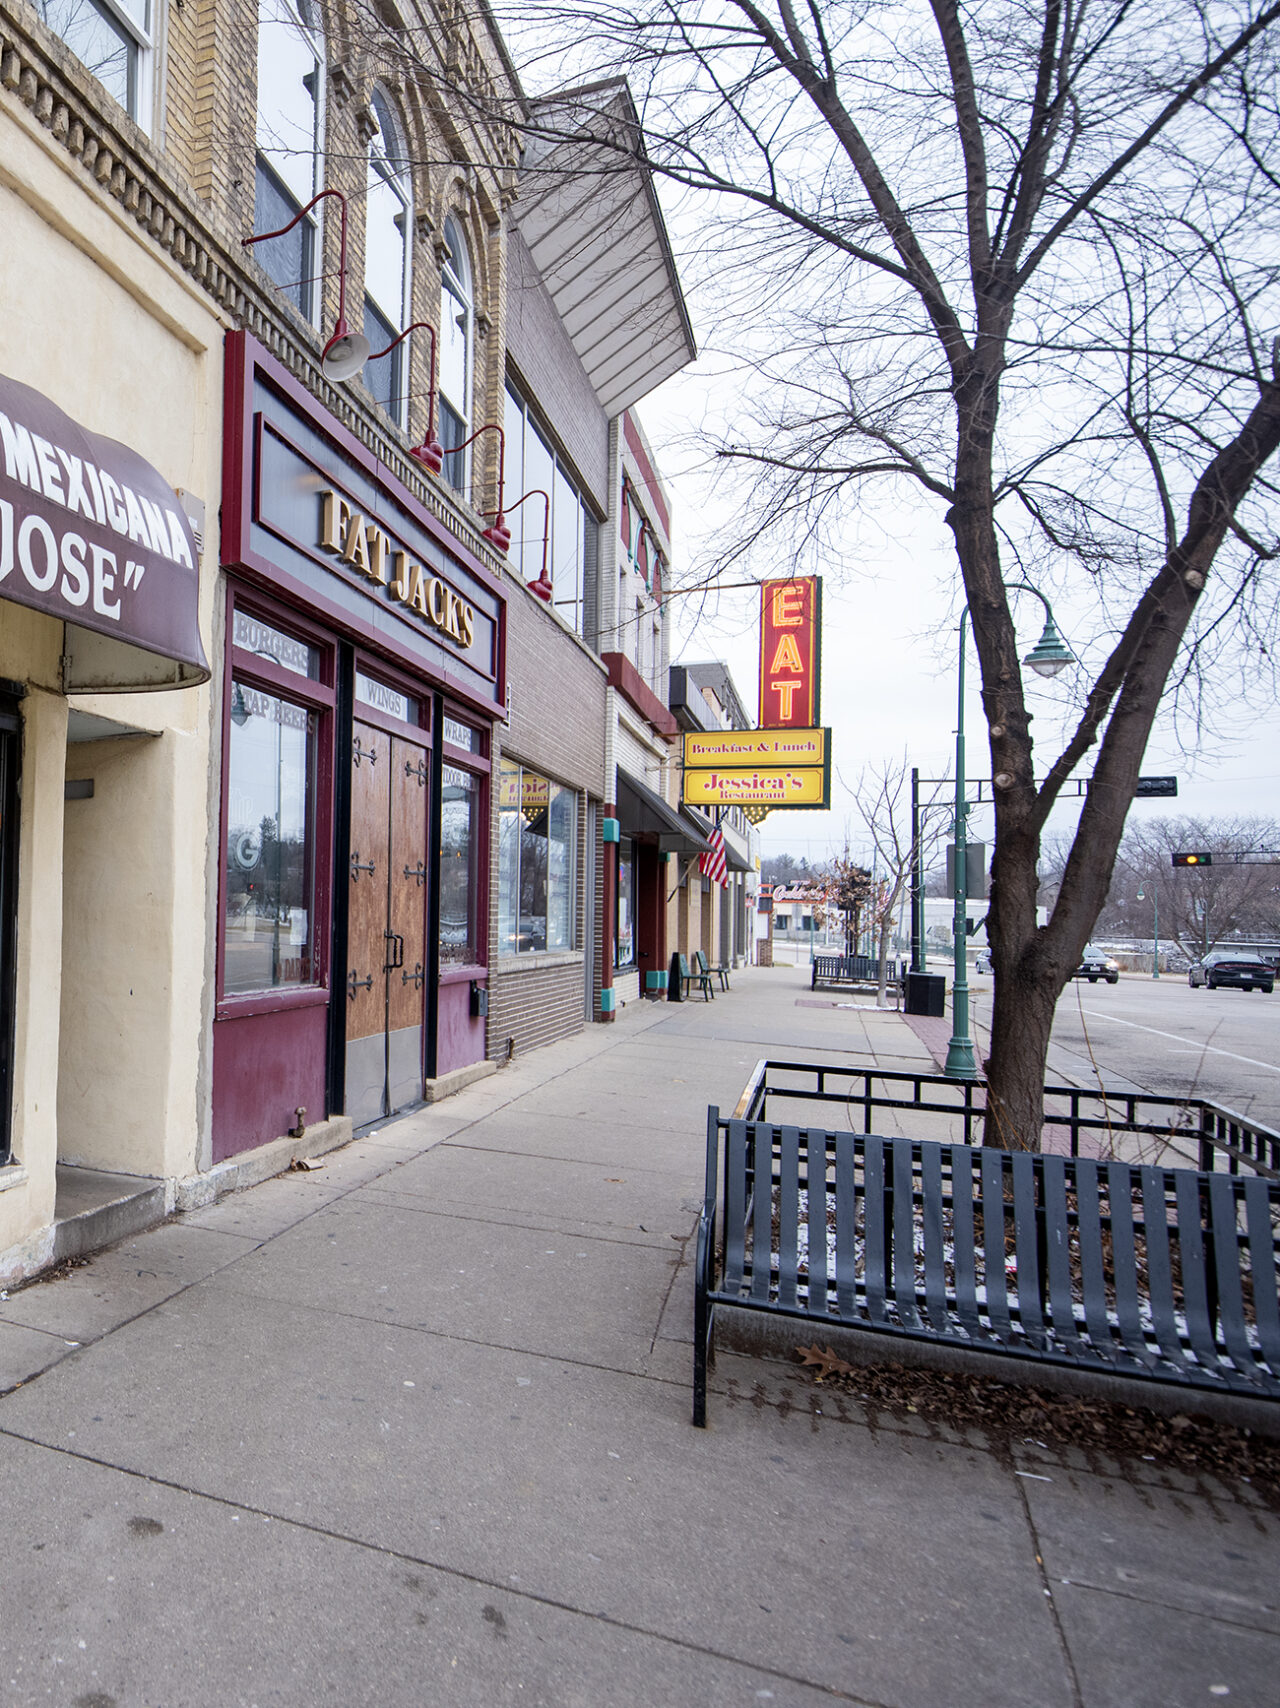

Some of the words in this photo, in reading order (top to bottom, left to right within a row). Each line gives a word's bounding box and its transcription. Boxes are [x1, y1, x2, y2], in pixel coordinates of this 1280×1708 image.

[320, 489, 391, 587] FAT
[391, 549, 474, 650] JACK'S
[236, 618, 308, 671] BURGERS
[770, 586, 804, 720] EAT
[242, 687, 269, 718] TAP
[274, 702, 315, 734] BEERS
[368, 680, 401, 715] WINGS
[445, 720, 471, 748] WRAPS
[691, 741, 754, 754] Breakfast
[757, 742, 769, 752] &
[774, 740, 816, 752] Lunch
[703, 773, 803, 790] Jessica's
[719, 790, 786, 799] Restaurant
